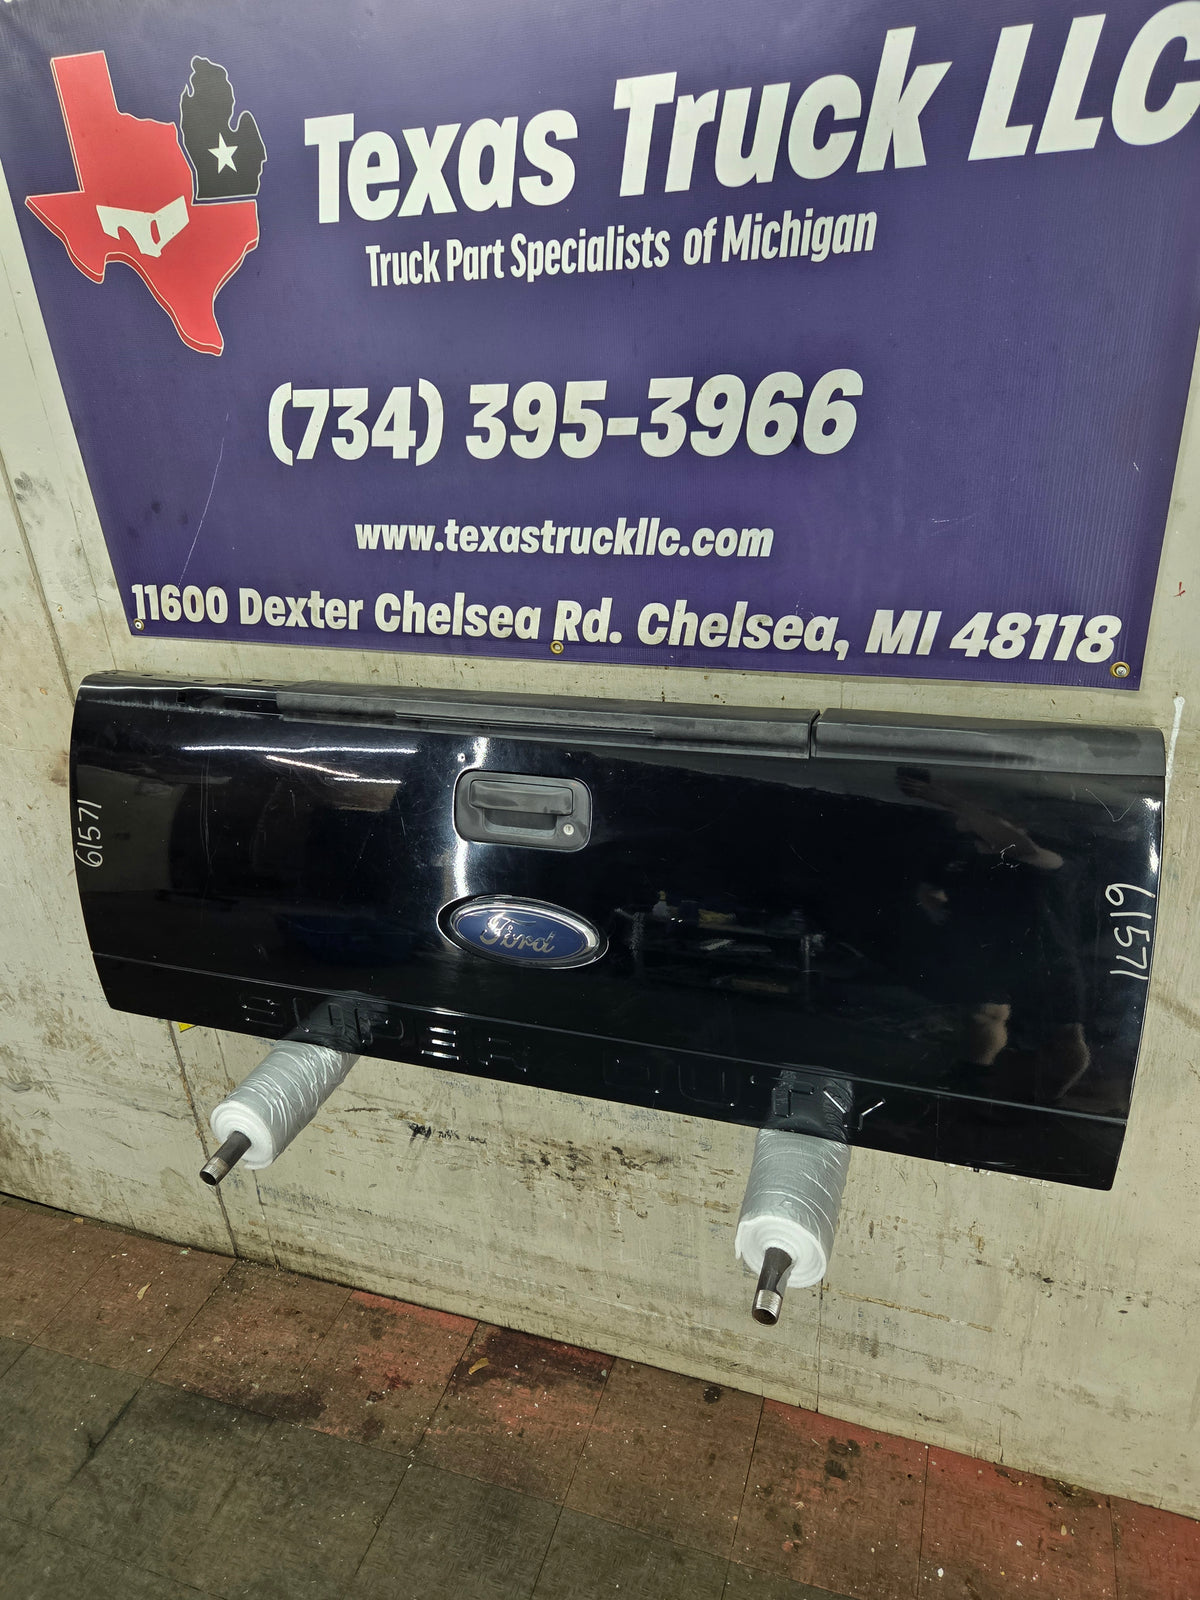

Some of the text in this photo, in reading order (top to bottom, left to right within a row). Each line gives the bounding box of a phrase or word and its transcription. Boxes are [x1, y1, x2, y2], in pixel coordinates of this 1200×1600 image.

[303, 0, 1200, 224] Texas Truck LLC
[365, 208, 878, 287] Truck Part Specialists of Michigan
[268, 368, 864, 467] (734) 395-3966
[354, 516, 775, 557] www.texastruckllc.com
[131, 583, 1123, 663] 11600 Dexter Chelsea Rd. Chelsea, MI 48118
[75, 799, 104, 868] 61571
[479, 910, 557, 954] Ford
[1104, 882, 1157, 981] 61571
